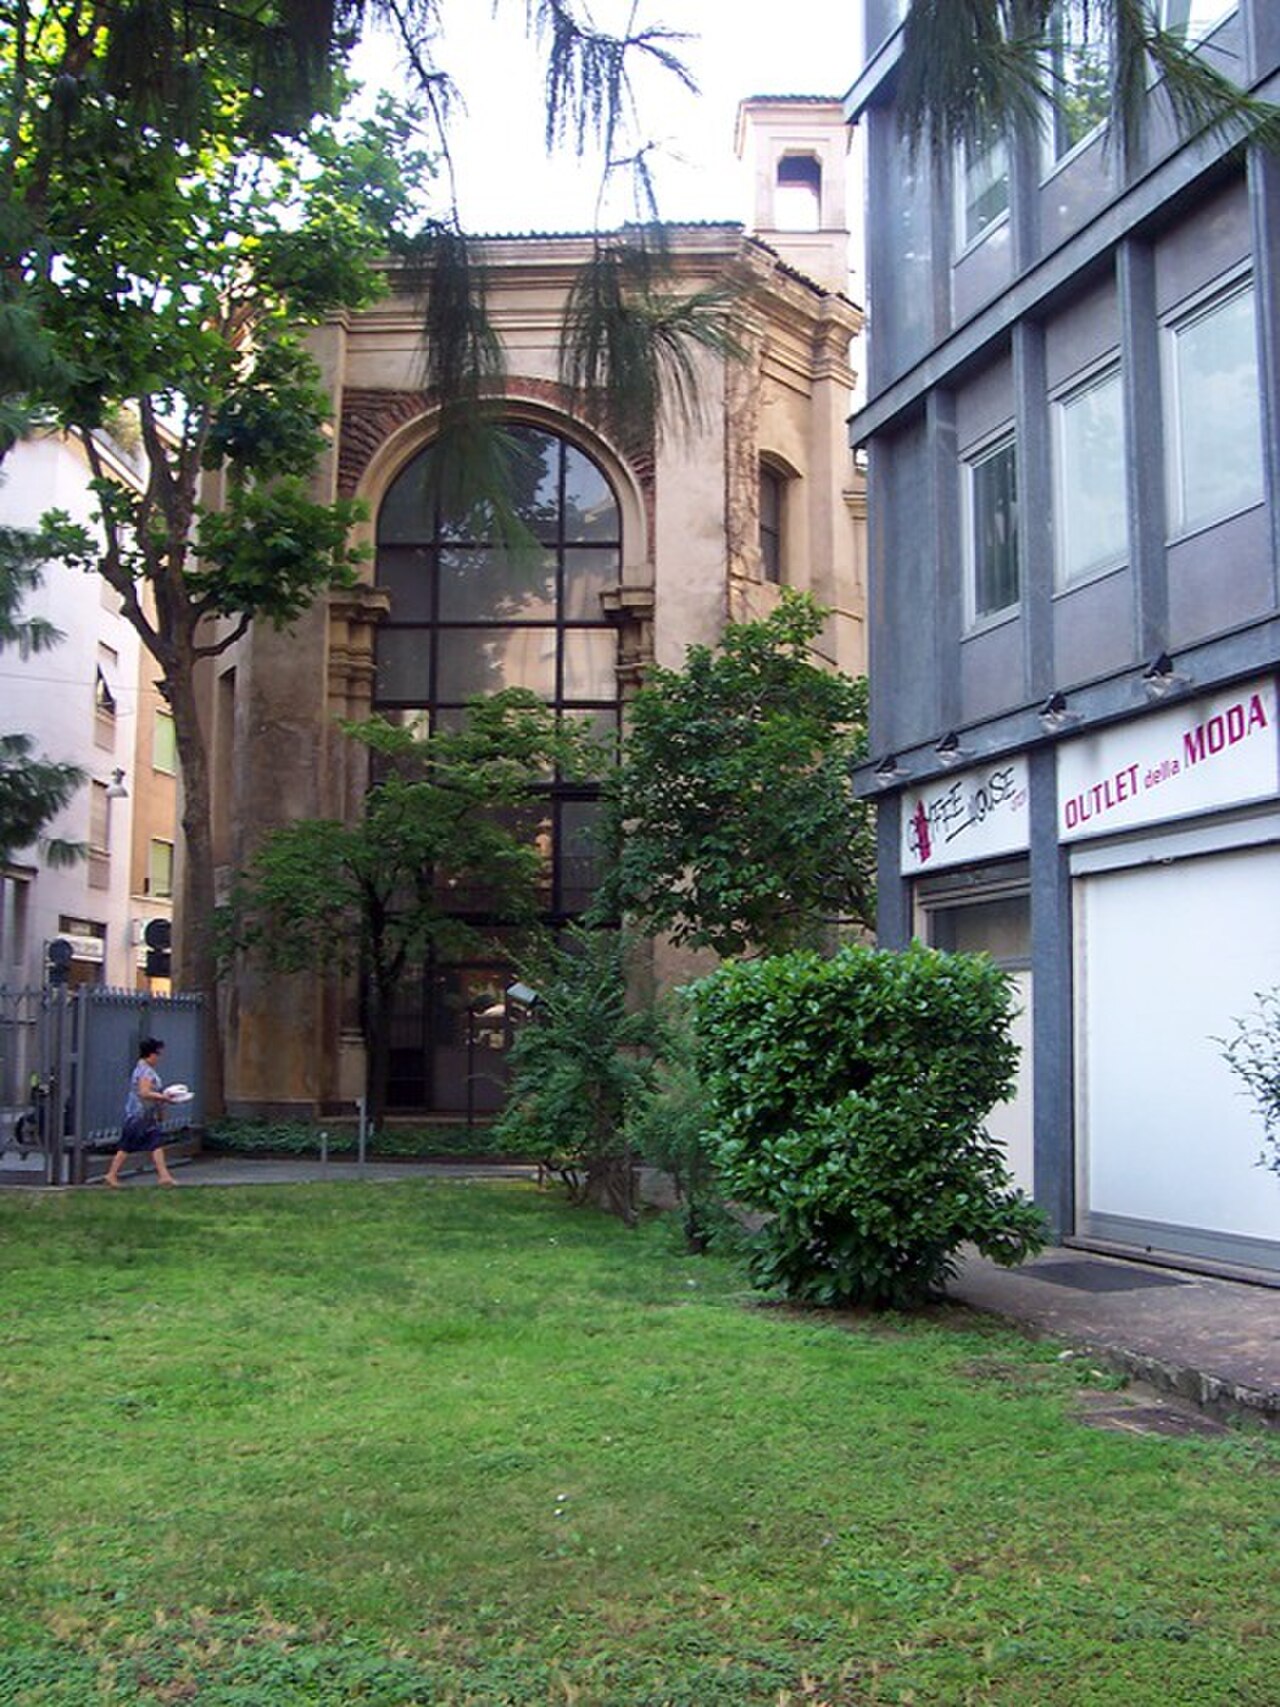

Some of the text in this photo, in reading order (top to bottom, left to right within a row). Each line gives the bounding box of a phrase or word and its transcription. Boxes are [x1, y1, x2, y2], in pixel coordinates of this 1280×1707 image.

[1064, 694, 1268, 829] OUTLET della MODA
